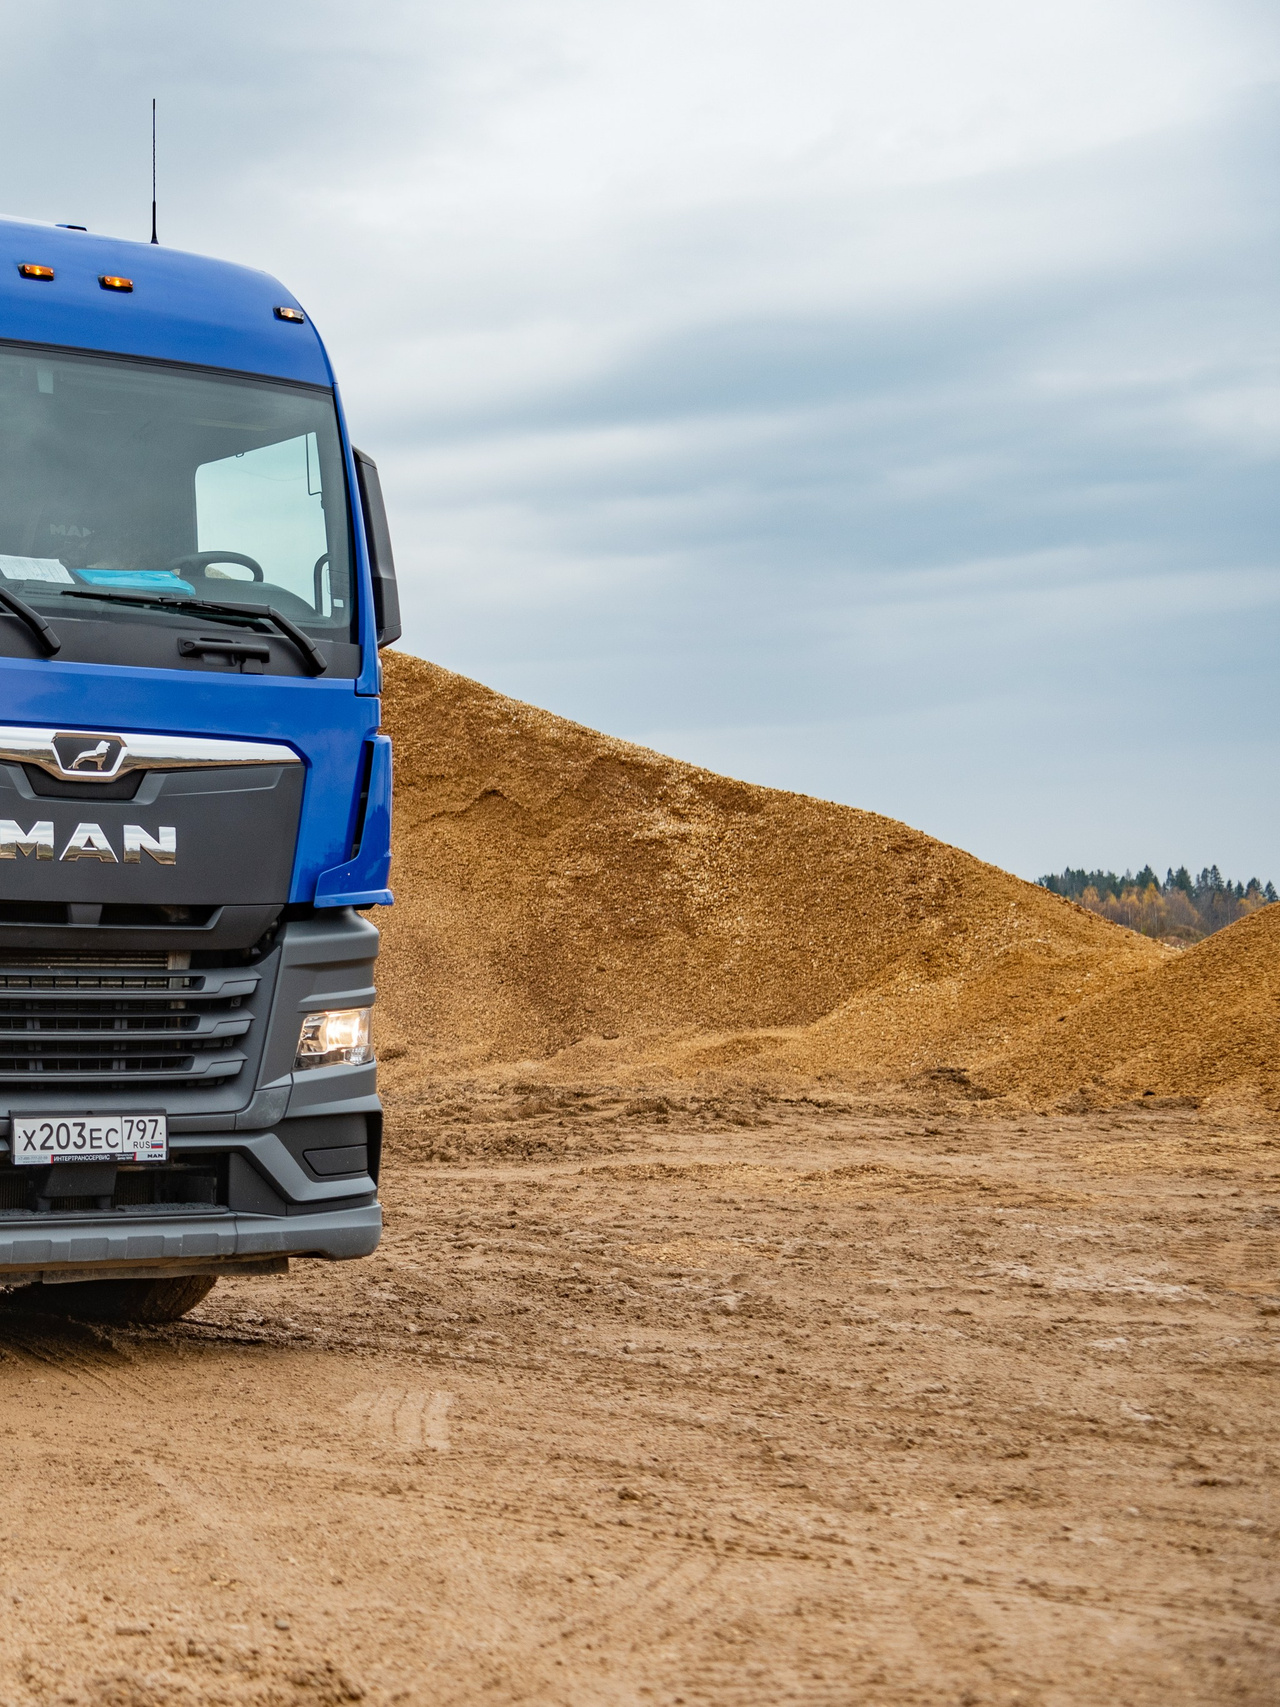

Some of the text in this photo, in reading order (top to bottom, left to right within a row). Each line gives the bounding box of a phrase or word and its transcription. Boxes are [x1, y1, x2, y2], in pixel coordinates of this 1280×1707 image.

[22, 1119, 159, 1151] Х203ЕС 797
[133, 1141, 150, 1149] RUS
[53, 1154, 111, 1162] ИНТЕРТРАНССЕРВИС
